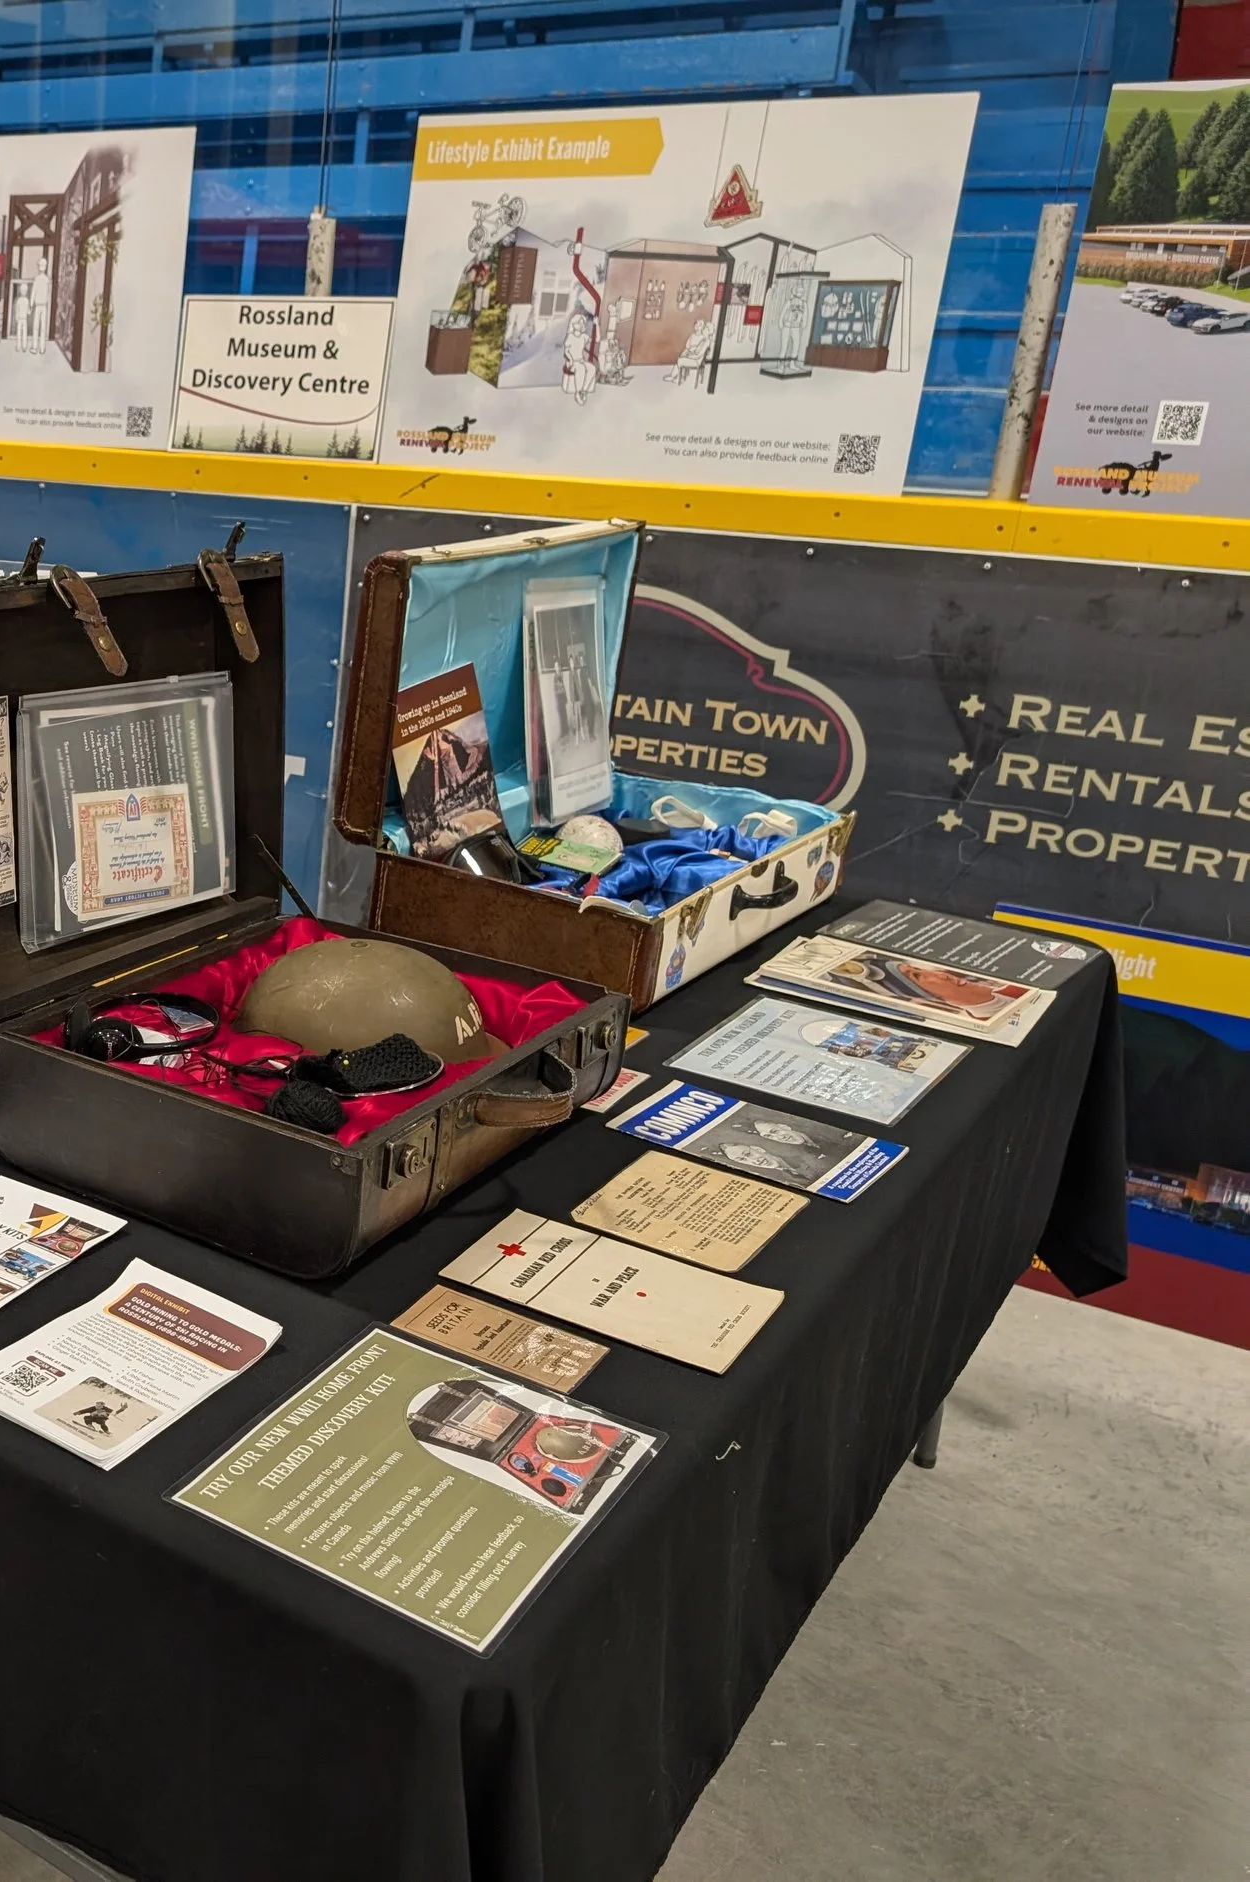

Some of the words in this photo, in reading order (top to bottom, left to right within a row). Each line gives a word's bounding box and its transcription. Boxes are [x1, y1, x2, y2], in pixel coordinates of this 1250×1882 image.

[427, 140, 488, 168] Lifestyle
[493, 137, 542, 161] Exhibit
[547, 135, 610, 164] Example
[239, 305, 334, 325] Rossland
[227, 338, 316, 359] Museum
[323, 340, 339, 359] &
[192, 369, 292, 396] Discovery
[299, 373, 369, 394] Centre
[1075, 403, 1091, 411] See
[1094, 404, 1118, 412] more
[1121, 404, 1149, 413] detail
[1098, 415, 1133, 425] designs
[1136, 416, 1148, 425] on
[646, 433, 660, 442] See
[663, 435, 686, 443] more
[688, 434, 712, 444] detail
[715, 436, 721, 445] &
[724, 437, 757, 448] designs
[774, 440, 790, 448] our
[792, 441, 831, 451] website:
[1106, 428, 1145, 437] website:
[664, 447, 680, 456] You
[682, 448, 697, 457] can
[699, 448, 717, 458] also
[719, 450, 753, 460] provide
[756, 449, 797, 462] feedback
[799, 454, 828, 464] online
[398, 707, 422, 723] Growing
[423, 704, 431, 713] up
[431, 700, 439, 709] in
[439, 686, 467, 705] Rossland
[401, 729, 408, 737] in
[409, 724, 418, 733] the
[435, 711, 445, 721] and
[705, 699, 828, 745] TOWN
[1007, 694, 1164, 747] REAL
[191, 750, 203, 786] HOME
[610, 734, 768, 778] PERTIES
[195, 789, 208, 829] FRONT
[112, 860, 162, 895] Certificate
[630, 1089, 729, 1142] COMINCO
[1, 1227, 29, 1240] KITS
[546, 1236, 574, 1253] CROSS
[536, 1250, 558, 1263] RED
[508, 1260, 547, 1289] CANADIAN
[613, 1265, 639, 1283] PEACE
[138, 1287, 166, 1302] DIGITAL
[589, 1292, 614, 1308] WAR
[602, 1281, 625, 1295] AND
[117, 1305, 158, 1327] ROSSLAND
[129, 1295, 153, 1308] GOLD
[149, 1305, 180, 1321] MINING
[176, 1318, 190, 1327] TO
[186, 1323, 210, 1337] GOLD
[206, 1333, 243, 1353] MEDALS:
[130, 1303, 166, 1323] CENTURY
[163, 1320, 177, 1328] OF
[173, 1325, 191, 1335] SKI
[186, 1332, 218, 1349] RACING
[215, 1346, 228, 1354] IN
[424, 1312, 449, 1329] SEEDS
[442, 1301, 462, 1313] FOR
[436, 1306, 474, 1334] BRITAIN
[197, 1473, 235, 1499] TRY
[224, 1449, 264, 1476] OUR
[254, 1424, 293, 1452] NEW
[283, 1398, 324, 1427] WWII
[313, 1371, 356, 1401] HOME
[345, 1343, 390, 1374] FRONT
[255, 1443, 317, 1491] THEMED
[306, 1393, 375, 1447] DISCOVERY
[363, 1373, 398, 1396] KIT!
[265, 1507, 290, 1526] These
[283, 1497, 301, 1510] kits
[294, 1488, 311, 1500] are
[303, 1473, 327, 1491] meant
[320, 1467, 334, 1476] to
[327, 1454, 348, 1470] spark
[280, 1505, 315, 1533] memories
[308, 1495, 326, 1508] and
[318, 1483, 339, 1498] start
[332, 1454, 370, 1486] discussions!
[356, 1544, 388, 1571] Andrews
[380, 1524, 408, 1547] Sisters,
[399, 1514, 417, 1527] and
[410, 1505, 426, 1516] get
[418, 1496, 434, 1508] the
[427, 1474, 456, 1499] nostalgia
[395, 1560, 429, 1590] Activities
[419, 1549, 439, 1564] and
[429, 1529, 457, 1553] prompt
[448, 1505, 480, 1533] questions
[498, 1557, 512, 1565] a
[502, 1539, 527, 1561] survey
[475, 1572, 499, 1592] filling
[489, 1562, 507, 1575] out
[453, 1589, 485, 1619] consider
